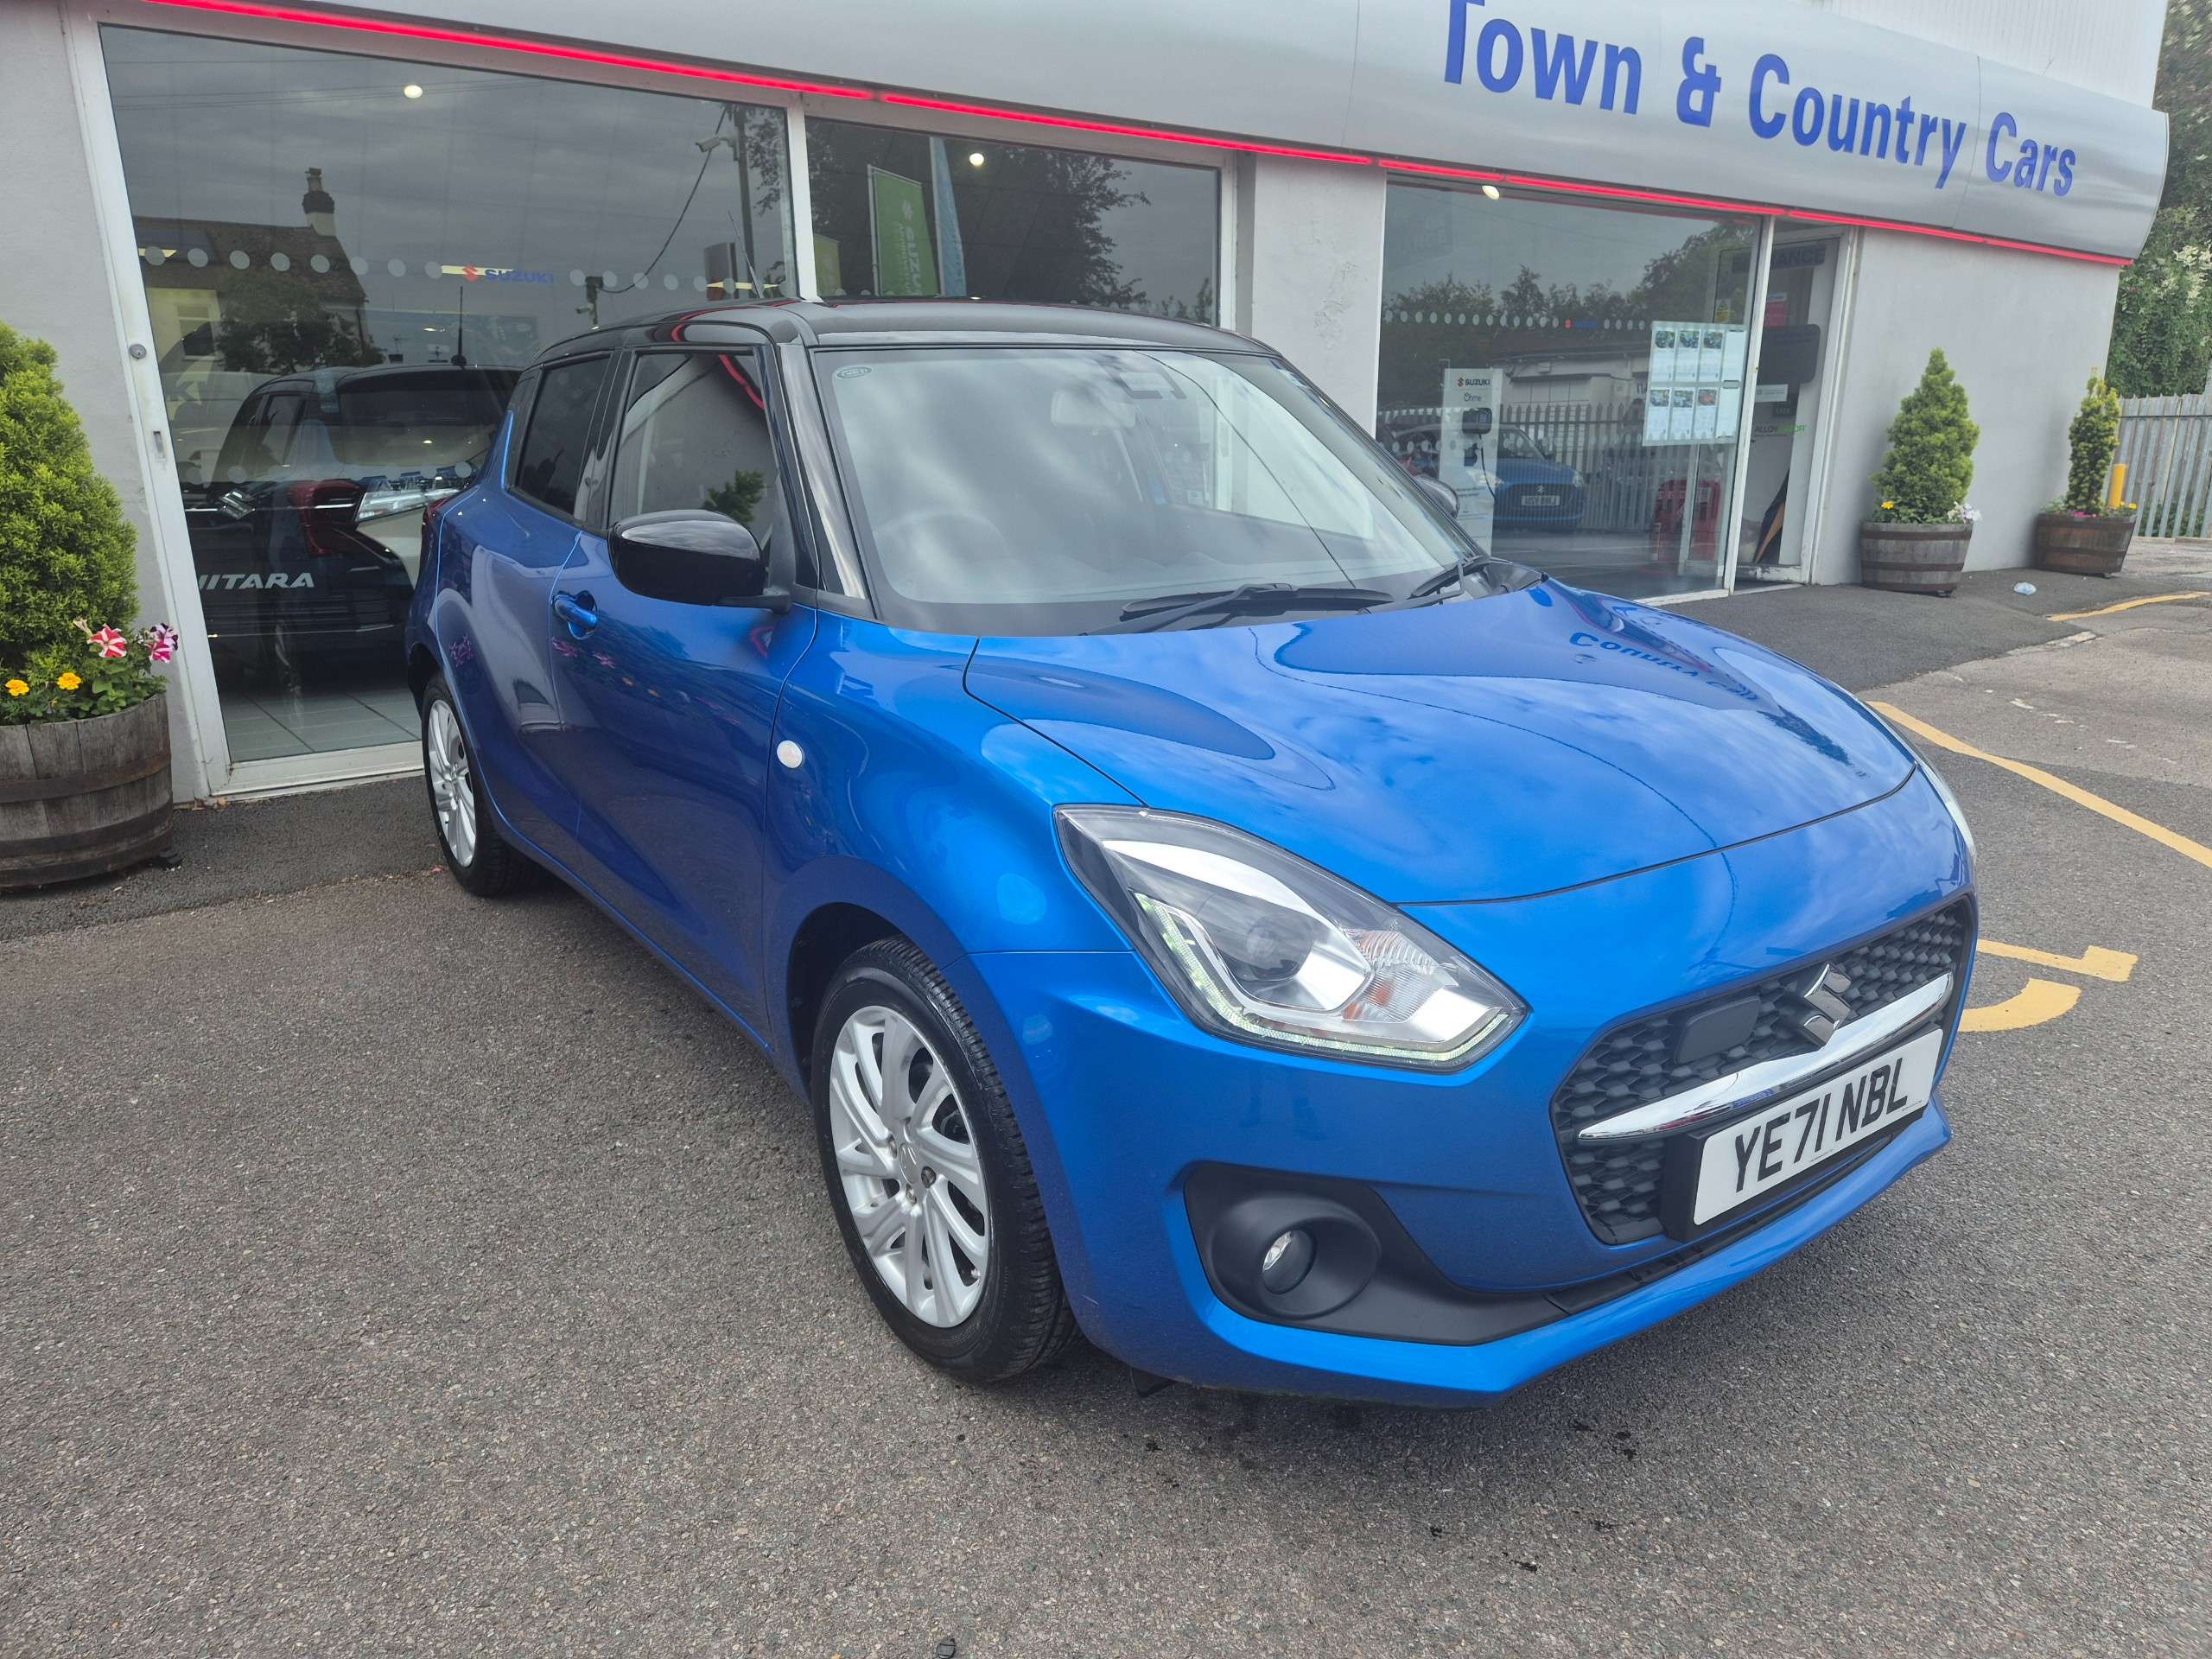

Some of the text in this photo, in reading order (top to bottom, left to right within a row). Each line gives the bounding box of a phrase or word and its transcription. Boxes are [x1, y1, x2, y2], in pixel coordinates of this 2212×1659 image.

[1444, 0, 2076, 197] Town & Country Cars
[484, 268, 555, 284] SUZUKI
[1465, 378, 1491, 386] SUZUKI
[1734, 1057, 1908, 1193] YE71 NBL
